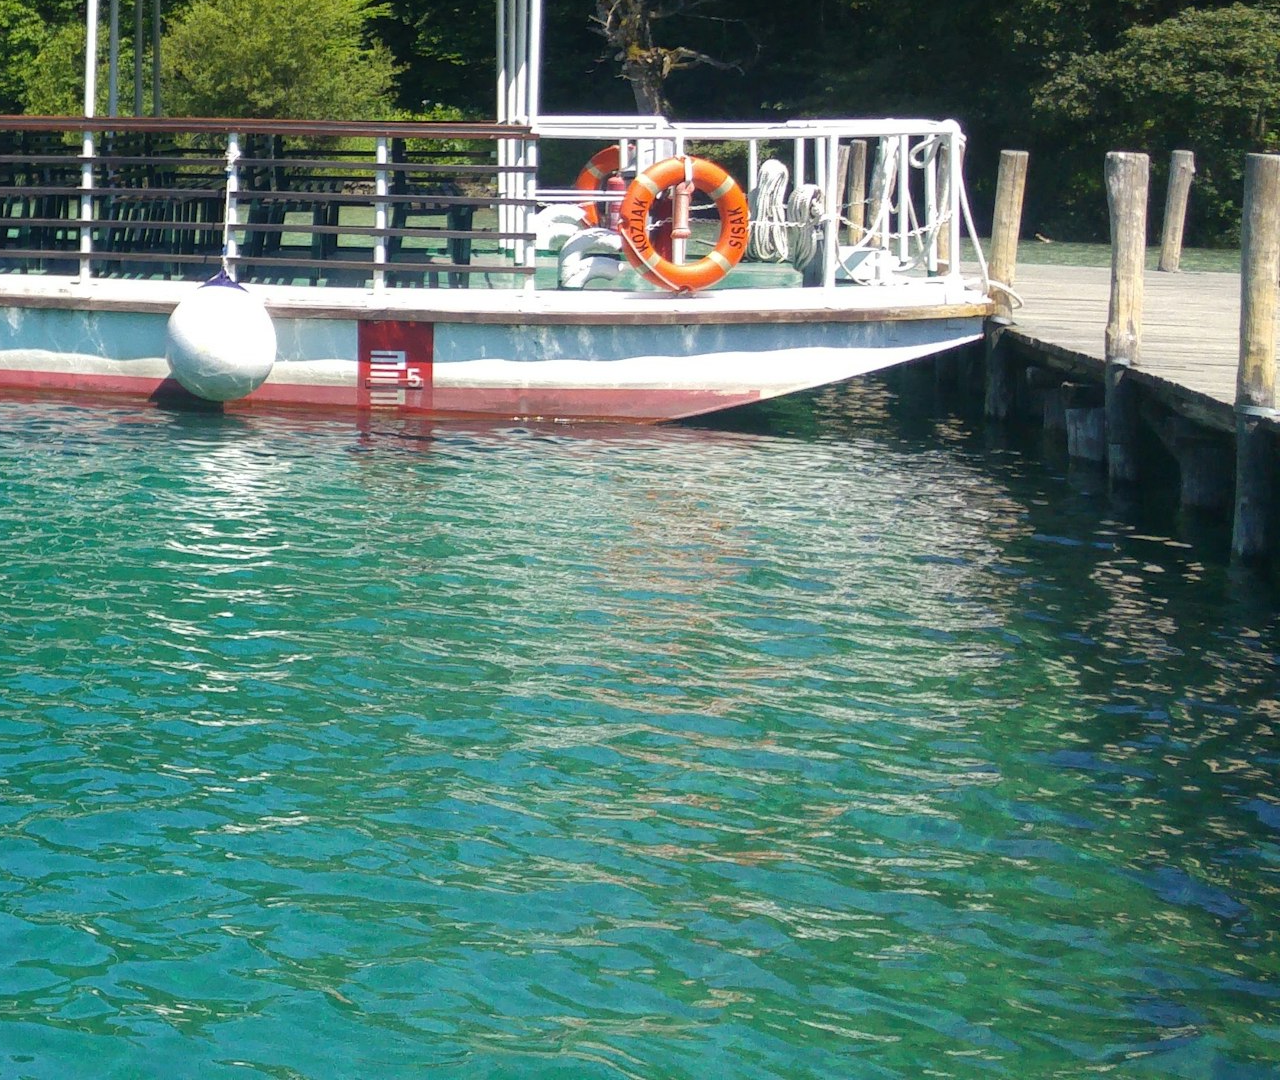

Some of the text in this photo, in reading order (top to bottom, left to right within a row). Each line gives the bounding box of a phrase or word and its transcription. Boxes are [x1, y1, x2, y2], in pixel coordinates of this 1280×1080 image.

[630, 197, 649, 253] KOZJAK
[727, 206, 746, 249] SISAK
[407, 368, 420, 387] 5
